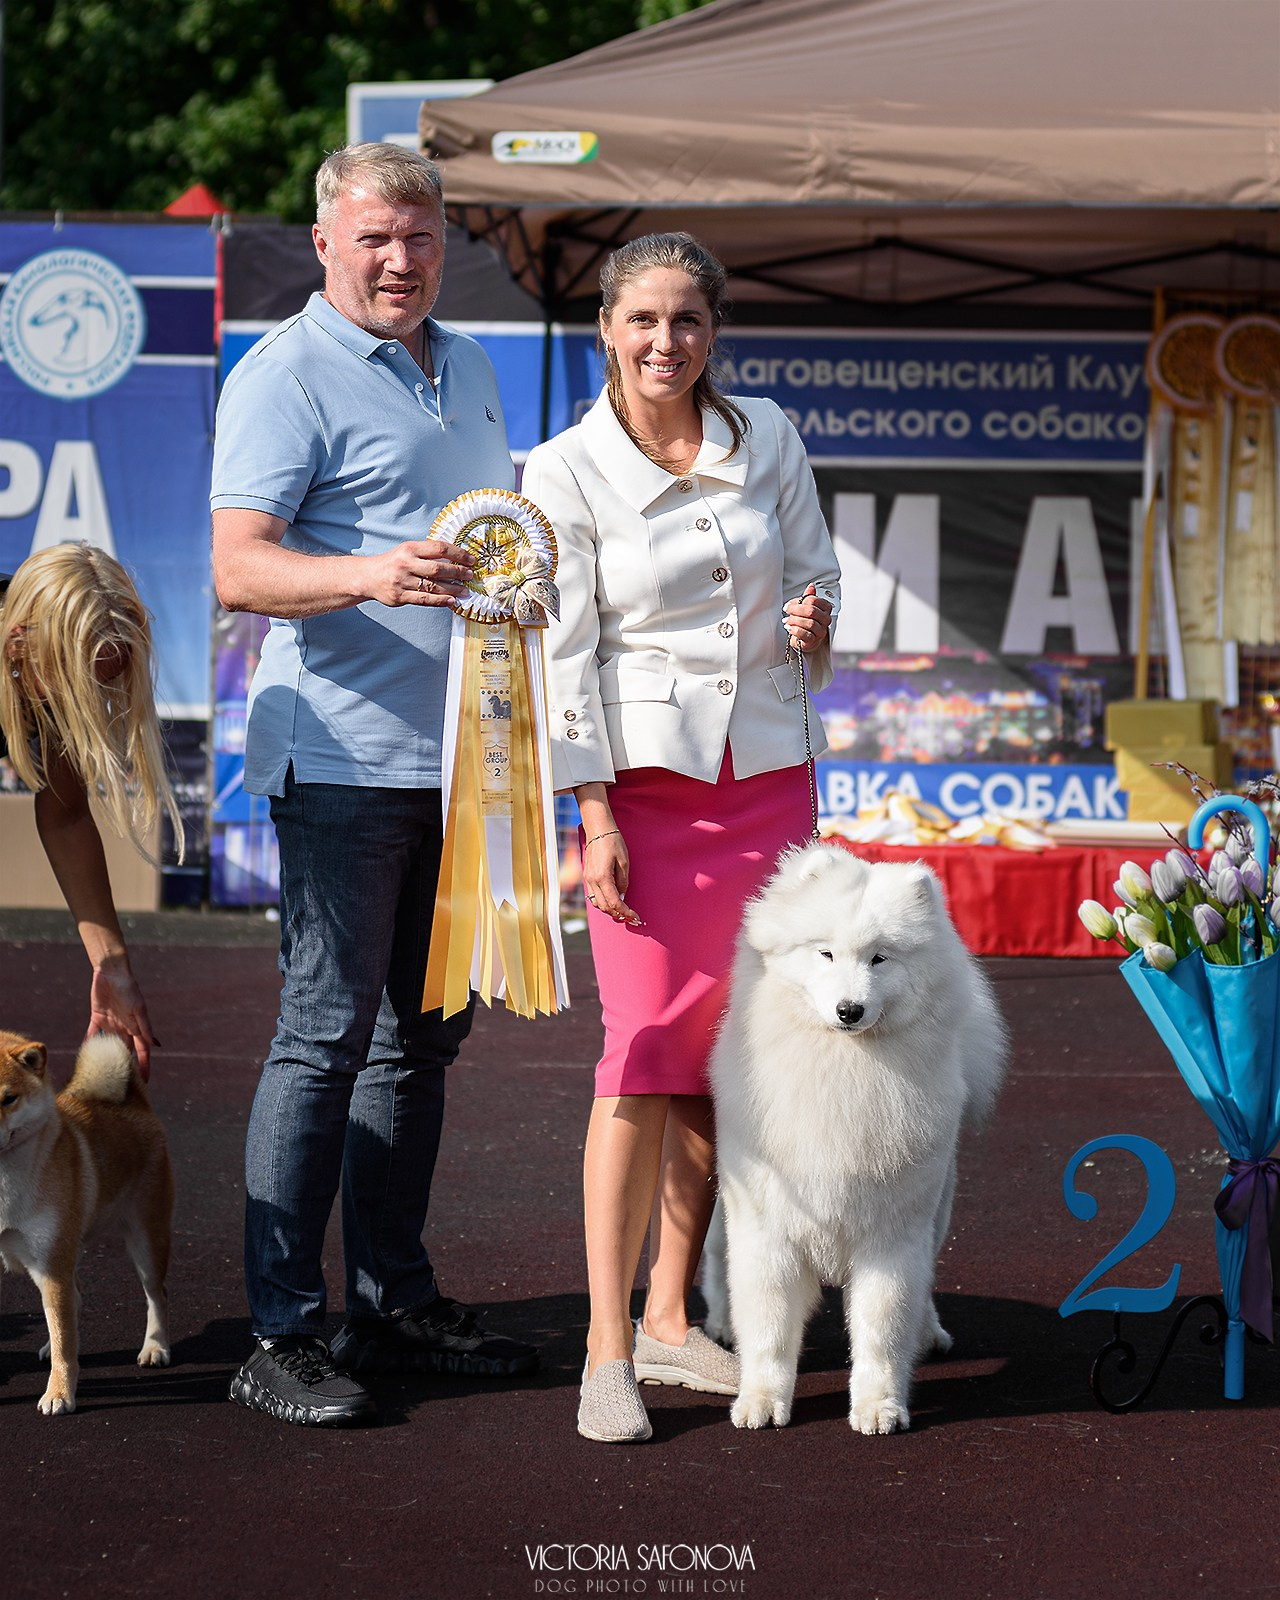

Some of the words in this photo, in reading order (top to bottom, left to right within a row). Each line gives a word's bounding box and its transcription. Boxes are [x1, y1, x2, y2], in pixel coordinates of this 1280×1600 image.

[718, 354, 1054, 390] лаговещенский
[1067, 354, 1148, 398] Клу
[982, 405, 1144, 440] собако
[494, 768, 501, 777] 2
[1058, 1133, 1182, 1318] 2
